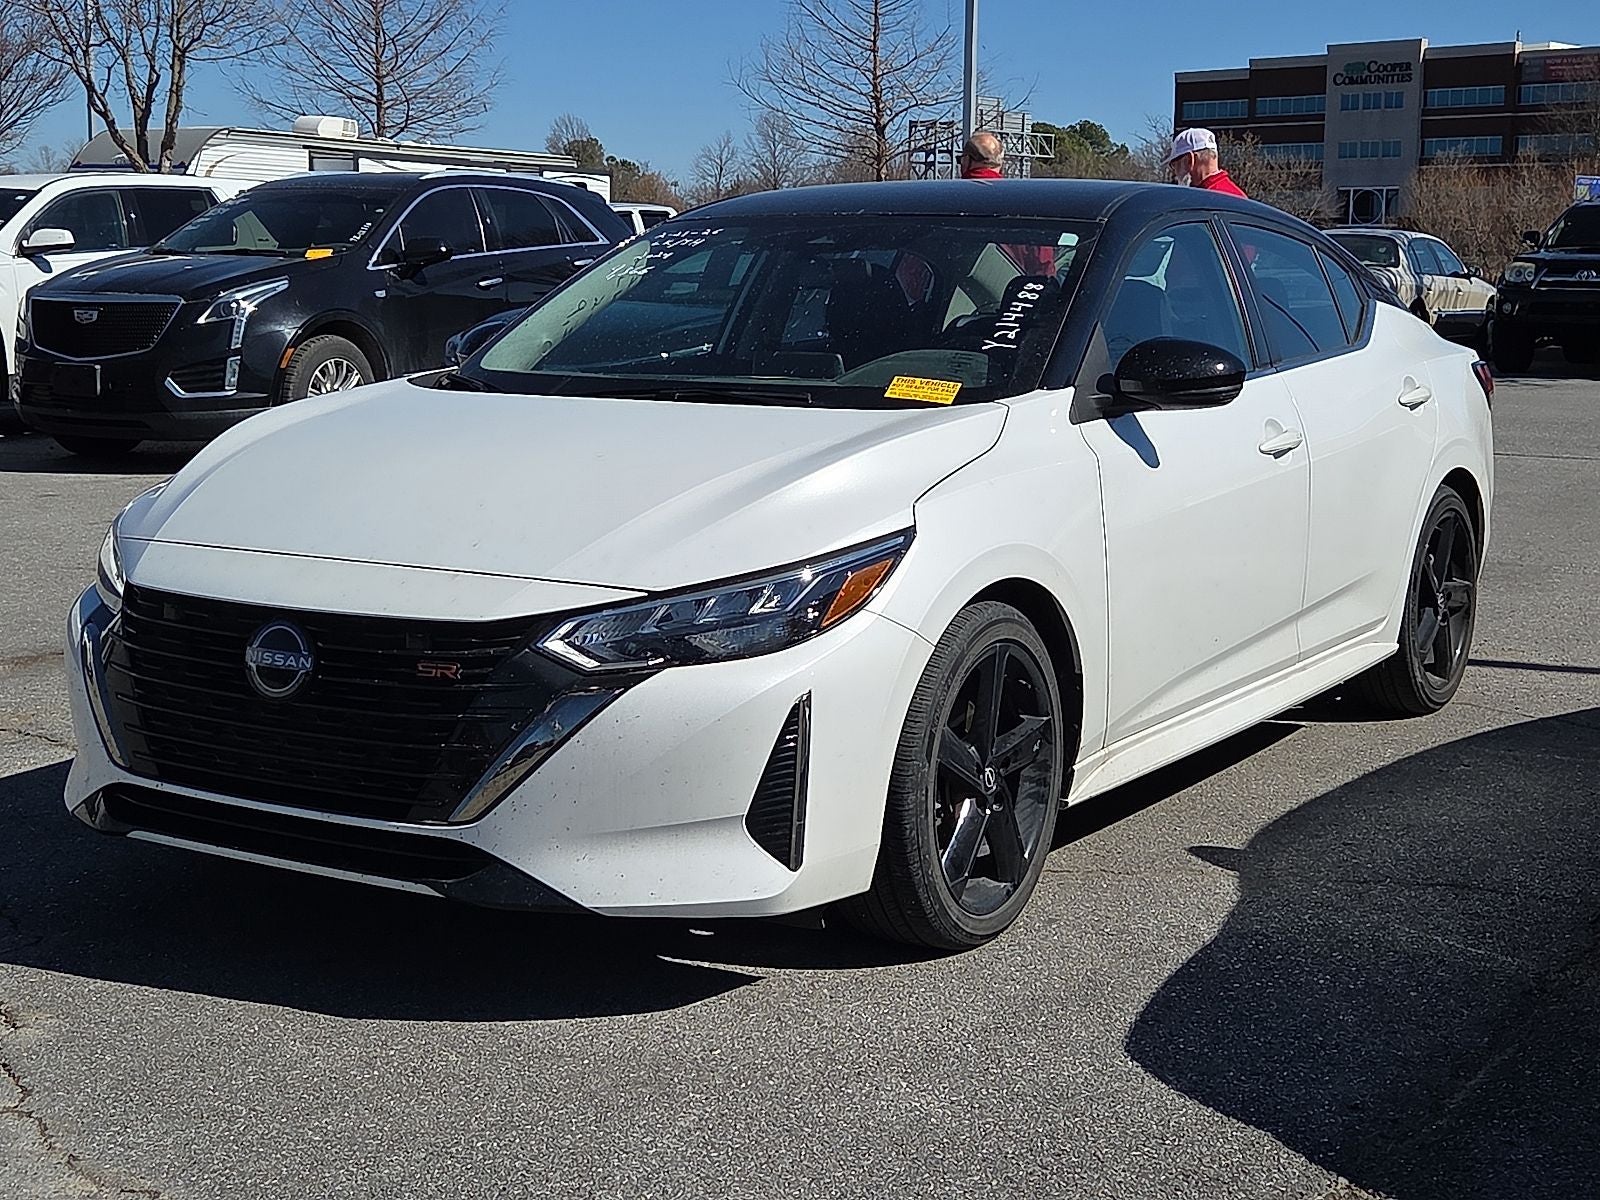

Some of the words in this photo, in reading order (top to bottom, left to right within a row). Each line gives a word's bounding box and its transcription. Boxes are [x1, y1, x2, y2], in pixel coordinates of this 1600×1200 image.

[981, 282, 1044, 351] Y214488
[896, 377, 917, 385] THIS
[919, 379, 959, 390] VEHICLE
[247, 645, 312, 668] NISSAN
[416, 659, 463, 679] SR
